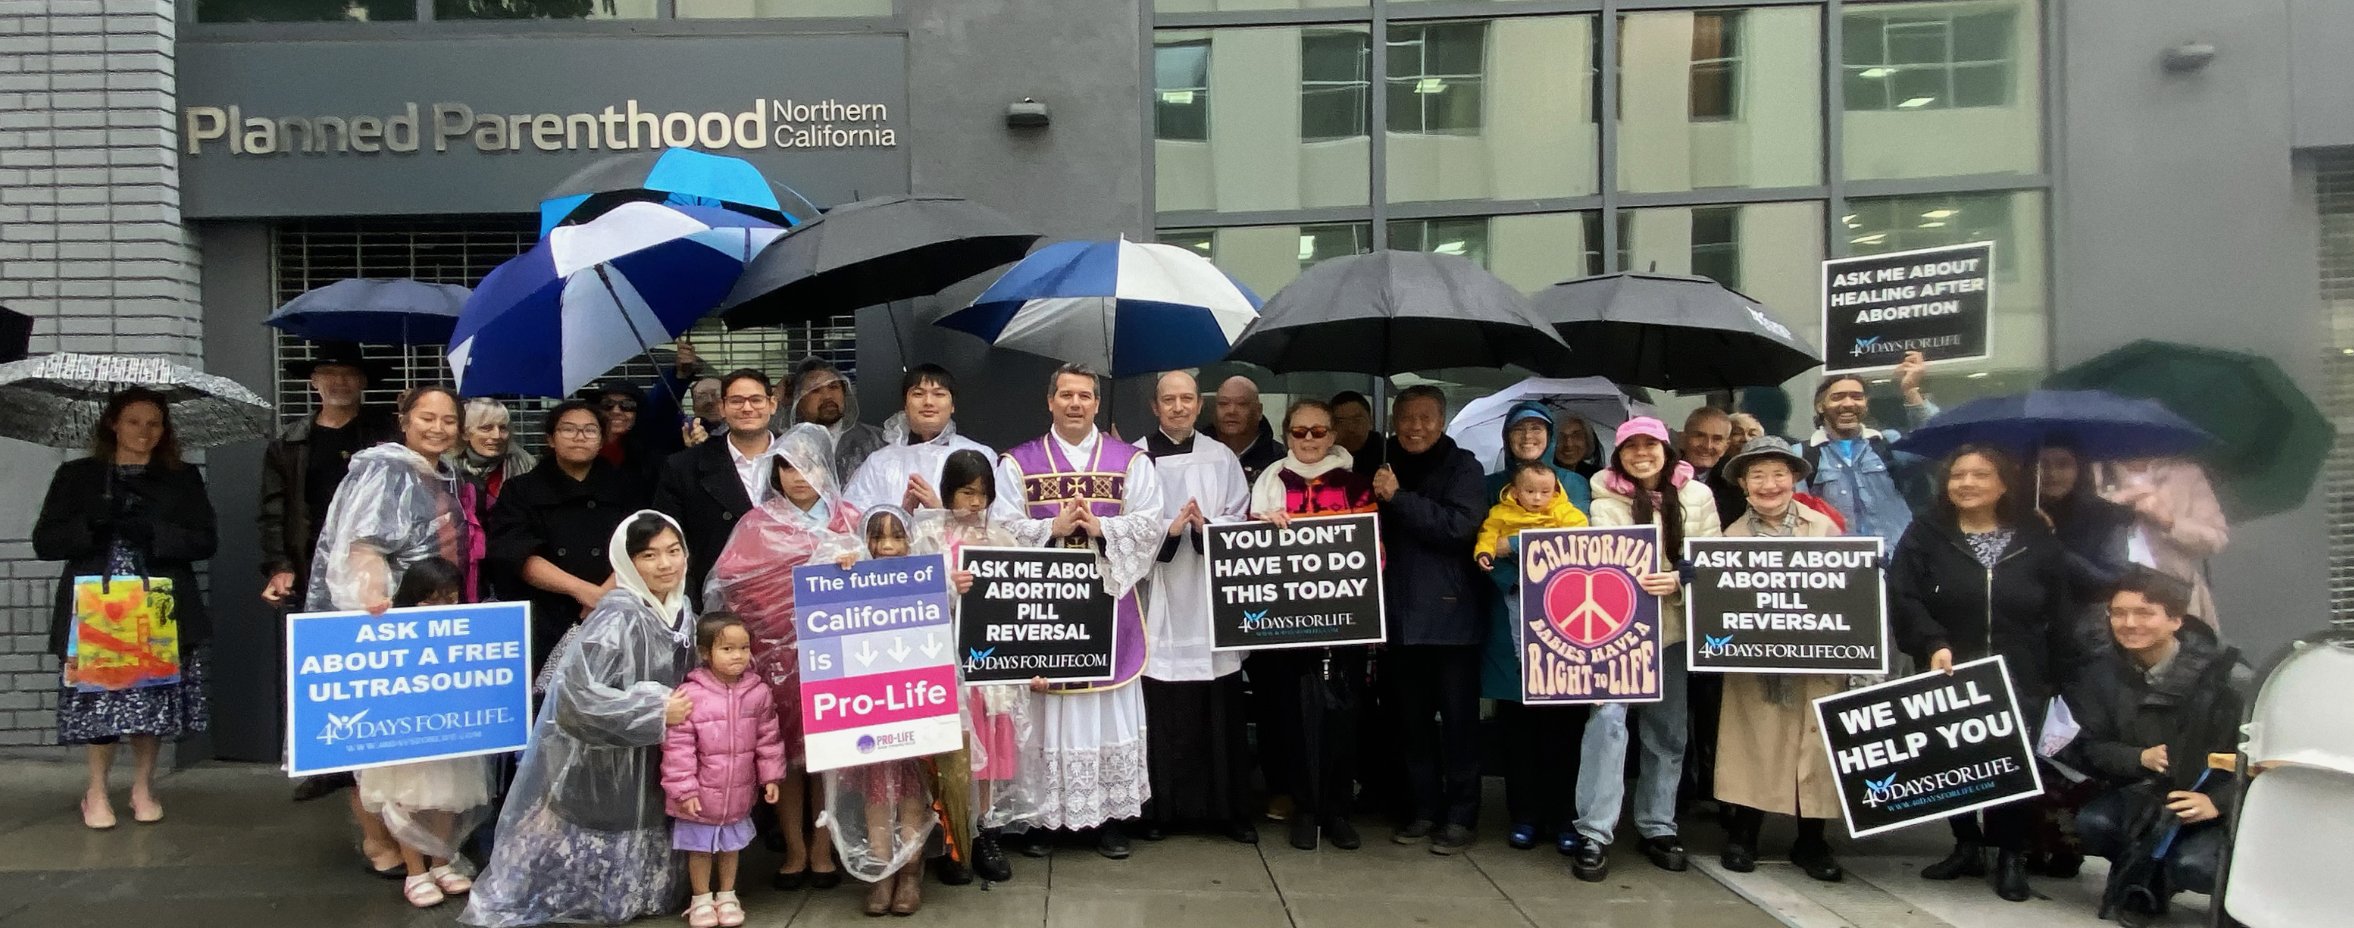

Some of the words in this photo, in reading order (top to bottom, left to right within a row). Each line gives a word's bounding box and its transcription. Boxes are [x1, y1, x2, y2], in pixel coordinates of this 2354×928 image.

[773, 99, 887, 122] Northern
[185, 102, 419, 156] Planned
[433, 98, 767, 153] Parenthood
[774, 124, 897, 149] California
[1833, 270, 1873, 288] ASK
[1877, 266, 1906, 283] ME
[1909, 258, 1980, 279] ABOUT
[1831, 285, 1916, 307] HEALING
[1920, 277, 1985, 298] AFTER
[1856, 299, 1961, 324] ABORTION
[1220, 529, 1273, 550] YOU
[1279, 524, 1357, 547] DON’T
[967, 560, 1009, 578] ASK
[1014, 561, 1043, 578] ME
[1047, 562, 1100, 579] ABOU
[1215, 556, 1282, 578] HAVE
[1287, 553, 1322, 573] TO
[1328, 550, 1366, 571] DO
[1526, 534, 1654, 591] CALIFORNIA
[1694, 551, 1743, 568] ASK
[1748, 551, 1783, 568] ME
[1789, 551, 1876, 568] ABOUT
[806, 576, 845, 592] The
[849, 572, 908, 589] future
[913, 566, 933, 582] of
[984, 582, 1090, 599] ABORTION
[1221, 583, 1279, 605] THIS
[1283, 578, 1368, 601] TODAY
[1717, 571, 1846, 589] ABORTION
[1017, 603, 1059, 620] PILL
[1756, 592, 1808, 609] PILL
[807, 600, 940, 633] California
[1722, 612, 1851, 631] REVERSAL
[355, 621, 418, 643] ASK
[428, 618, 470, 638] ME
[986, 624, 1091, 641] REVERSAL
[1591, 631, 1639, 663] HAVE
[1634, 622, 1650, 636] A
[300, 649, 409, 675] ABOUT
[418, 647, 439, 666] A
[448, 641, 520, 663] FREE
[808, 650, 832, 672] is
[1528, 643, 1593, 695] RIGHT
[1594, 673, 1608, 688] TO
[1608, 640, 1656, 695] LIFE
[308, 668, 513, 702] ULTRASOUND
[813, 680, 947, 721] Pro-Life
[1839, 701, 1896, 735] WE
[1901, 680, 1991, 720] WILL
[316, 721, 353, 745] 40
[356, 716, 412, 739] DAYS
[415, 711, 461, 733] FOR
[464, 706, 509, 727] LIFE
[876, 731, 915, 746] PRO-LIFE
[1837, 732, 1928, 774] HELP
[1935, 710, 2013, 749] YOU
[1862, 788, 1890, 809] 40
[1888, 775, 1935, 800] DAYS
[1934, 766, 1977, 789] FOR
[1973, 756, 2015, 780] LIFE
